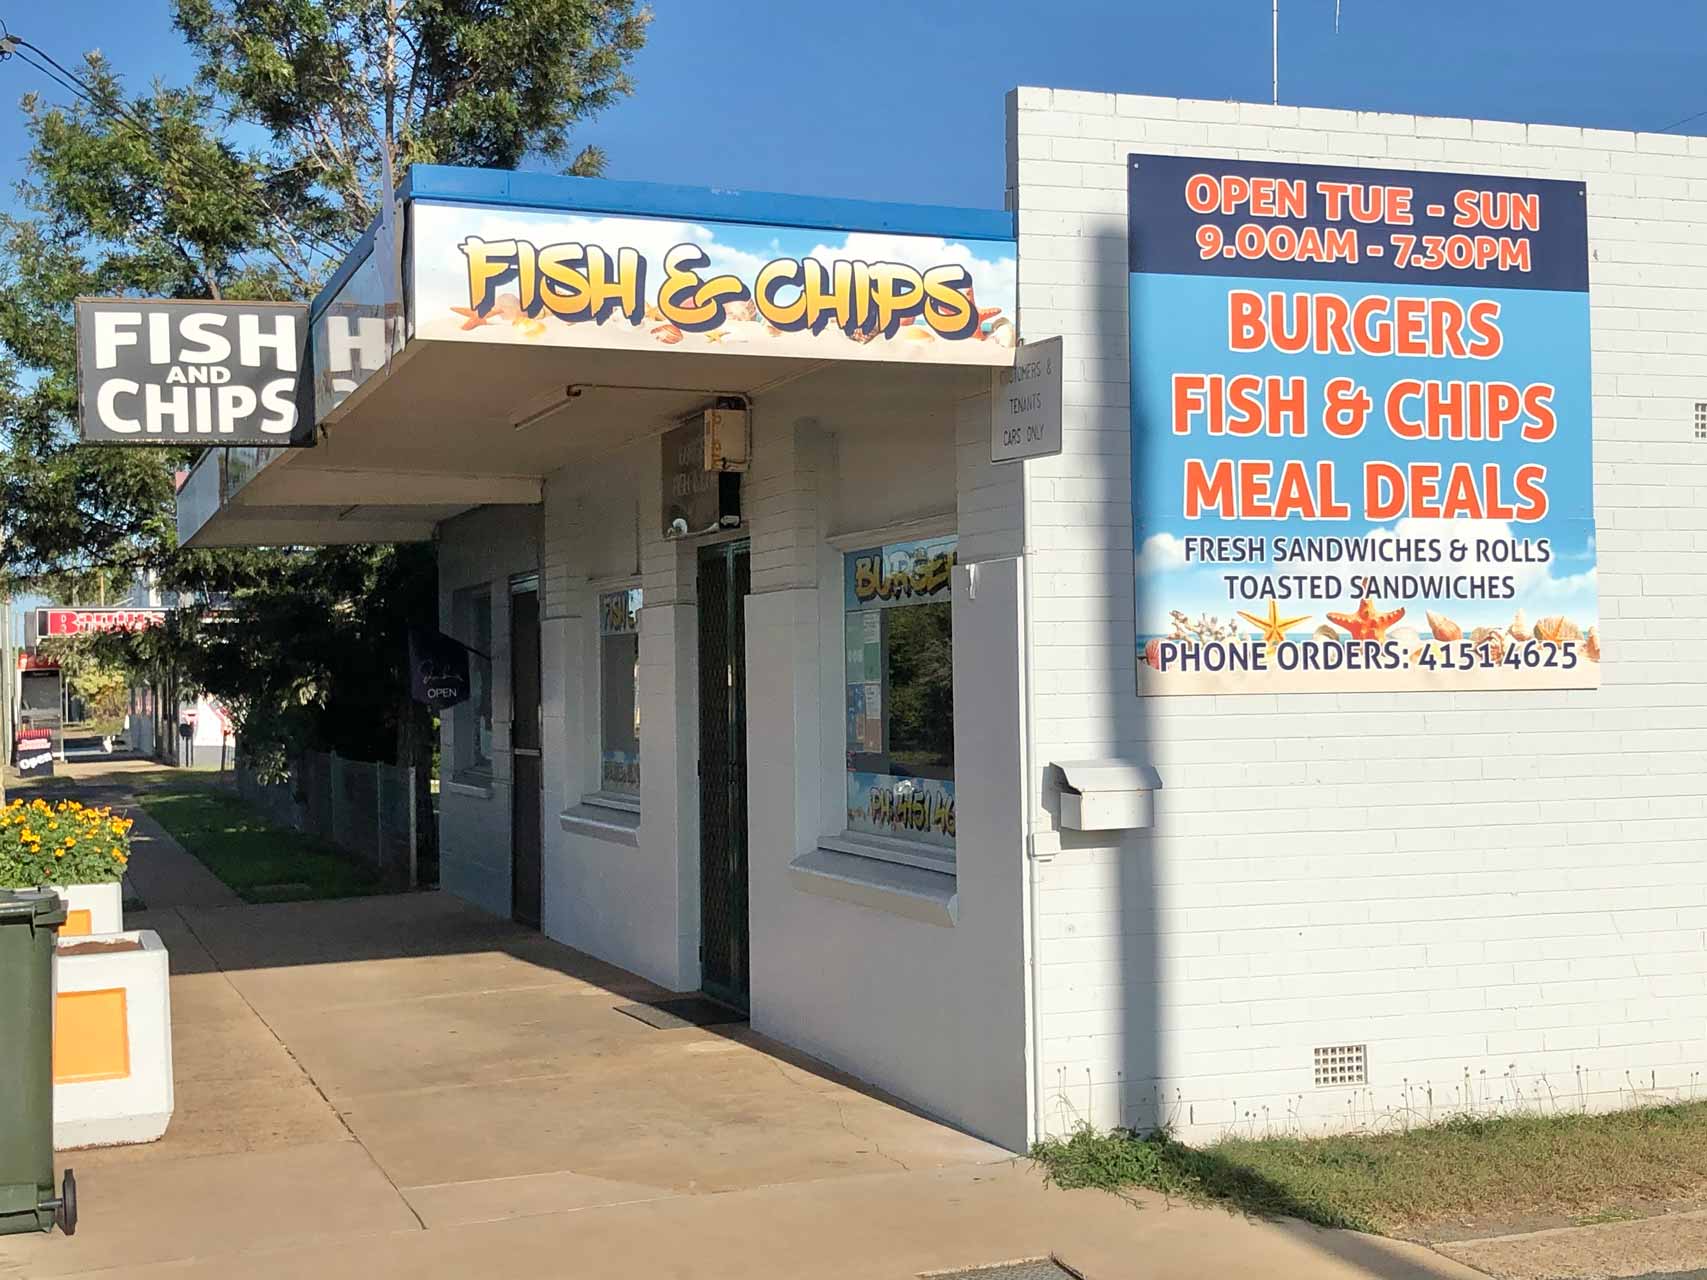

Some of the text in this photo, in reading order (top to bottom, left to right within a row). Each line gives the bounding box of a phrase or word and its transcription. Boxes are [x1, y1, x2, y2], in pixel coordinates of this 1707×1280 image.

[1186, 174, 1307, 218] OPEN
[1317, 181, 1414, 225] TUE
[1454, 189, 1539, 230] SUN
[1195, 225, 1357, 263] 9.00AM
[1391, 235, 1532, 272] 7.30PM
[458, 235, 978, 343] FISH & CHIPS
[93, 311, 298, 372] FISH
[1227, 290, 1503, 360] BURGERS
[166, 366, 231, 384] AND
[96, 377, 299, 434] CHIPS
[1009, 392, 1042, 415] TENANTS
[1171, 374, 1556, 443] FISH & CHIPS
[1003, 424, 1045, 447] CARS ONLY
[1183, 459, 1548, 522] MEAL DEALS
[1184, 537, 1550, 562] FRESH SANDWICHES & ROLLS
[1224, 575, 1515, 600] TOASTED SANDWICHES
[1160, 640, 1577, 672] PHONE ORDERS: 4151 4625
[427, 687, 457, 699] OPEN
[20, 752, 52, 770] Open
